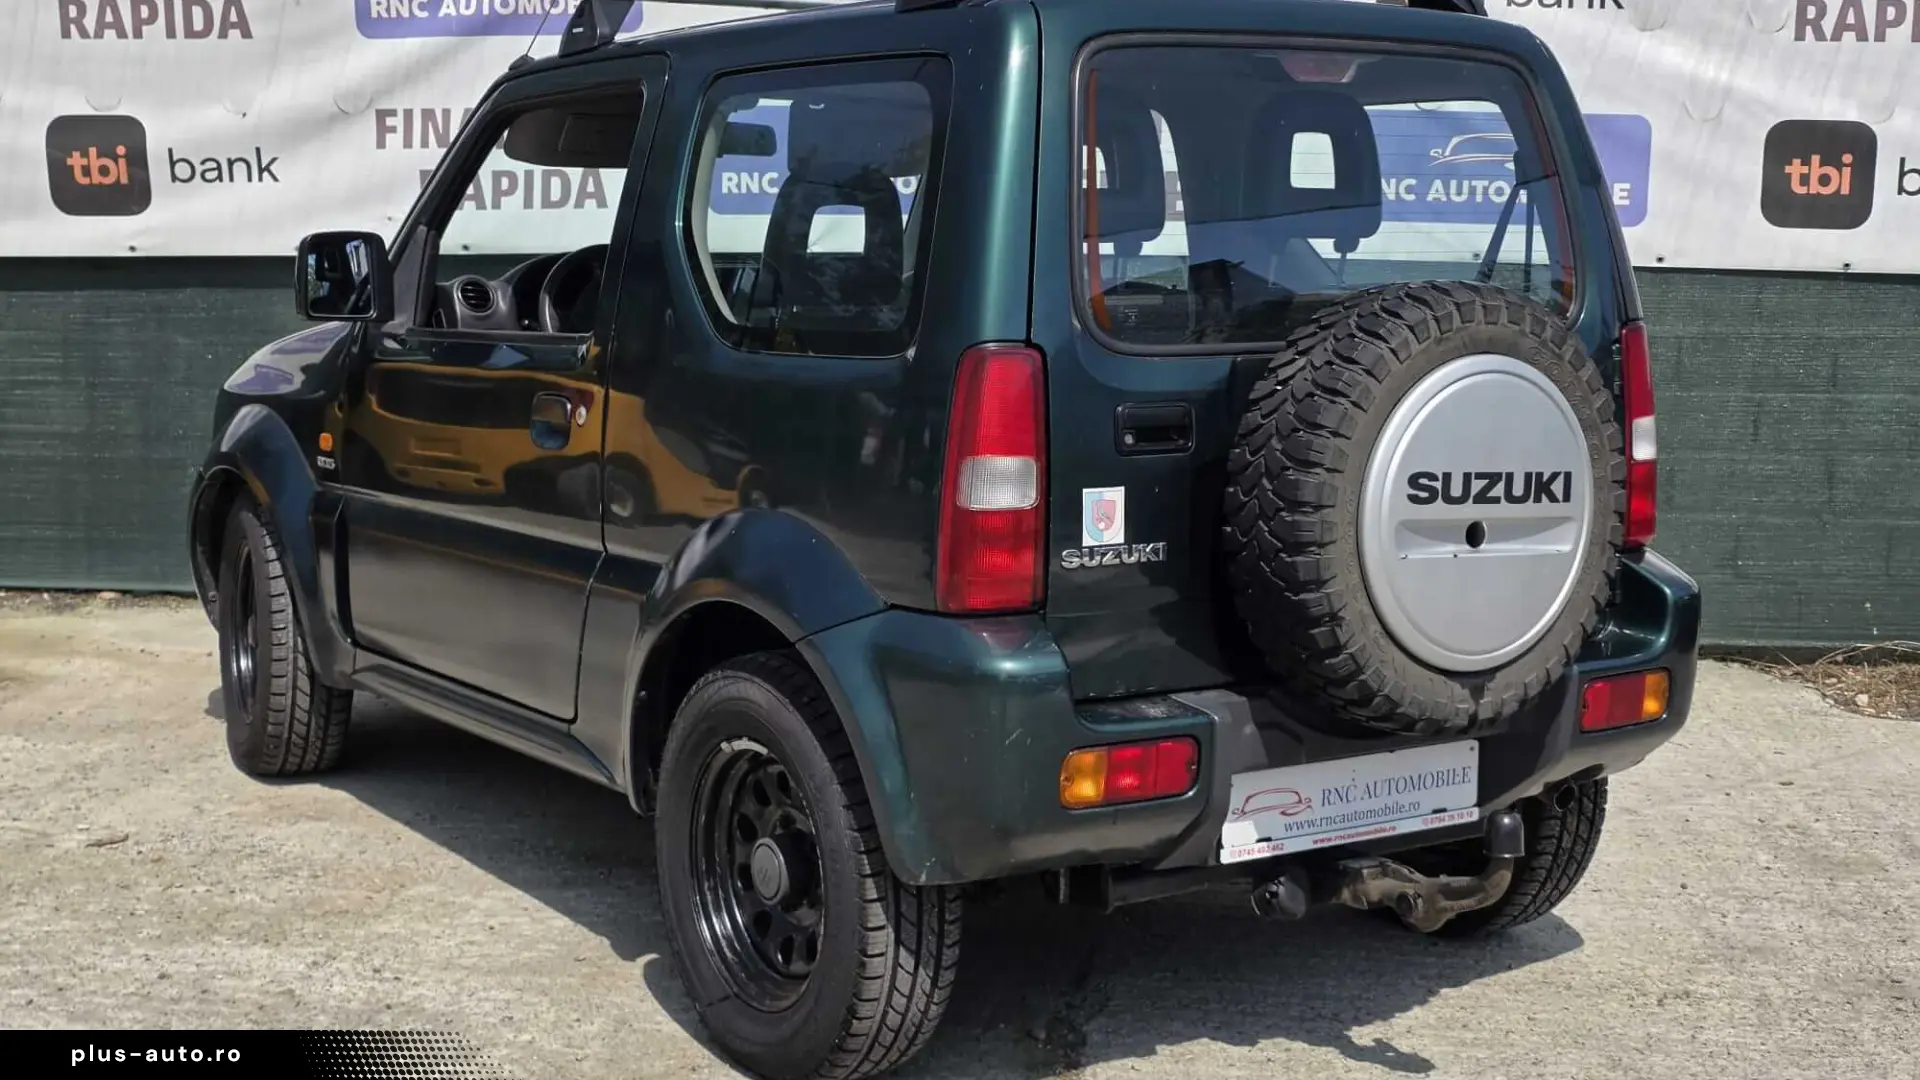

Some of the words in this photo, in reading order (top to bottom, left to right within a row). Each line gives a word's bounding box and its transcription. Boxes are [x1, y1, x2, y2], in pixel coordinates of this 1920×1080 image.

[58, 0, 253, 39] RAPIDA
[370, 0, 429, 18] RNC
[375, 107, 474, 150] FIN
[66, 145, 129, 185] tbi
[168, 146, 280, 183] bank
[721, 171, 779, 194] RNC
[1784, 153, 1853, 195] tbi
[419, 168, 608, 211] APIDA
[1381, 178, 1417, 201] NC
[1406, 471, 1572, 505] SUZUKI
[1061, 542, 1167, 569] SUZUKI
[1321, 783, 1358, 807] RNC
[1360, 766, 1473, 801] AUTOMOBILE
[1284, 800, 1420, 833] www.rncautomobile.ro
